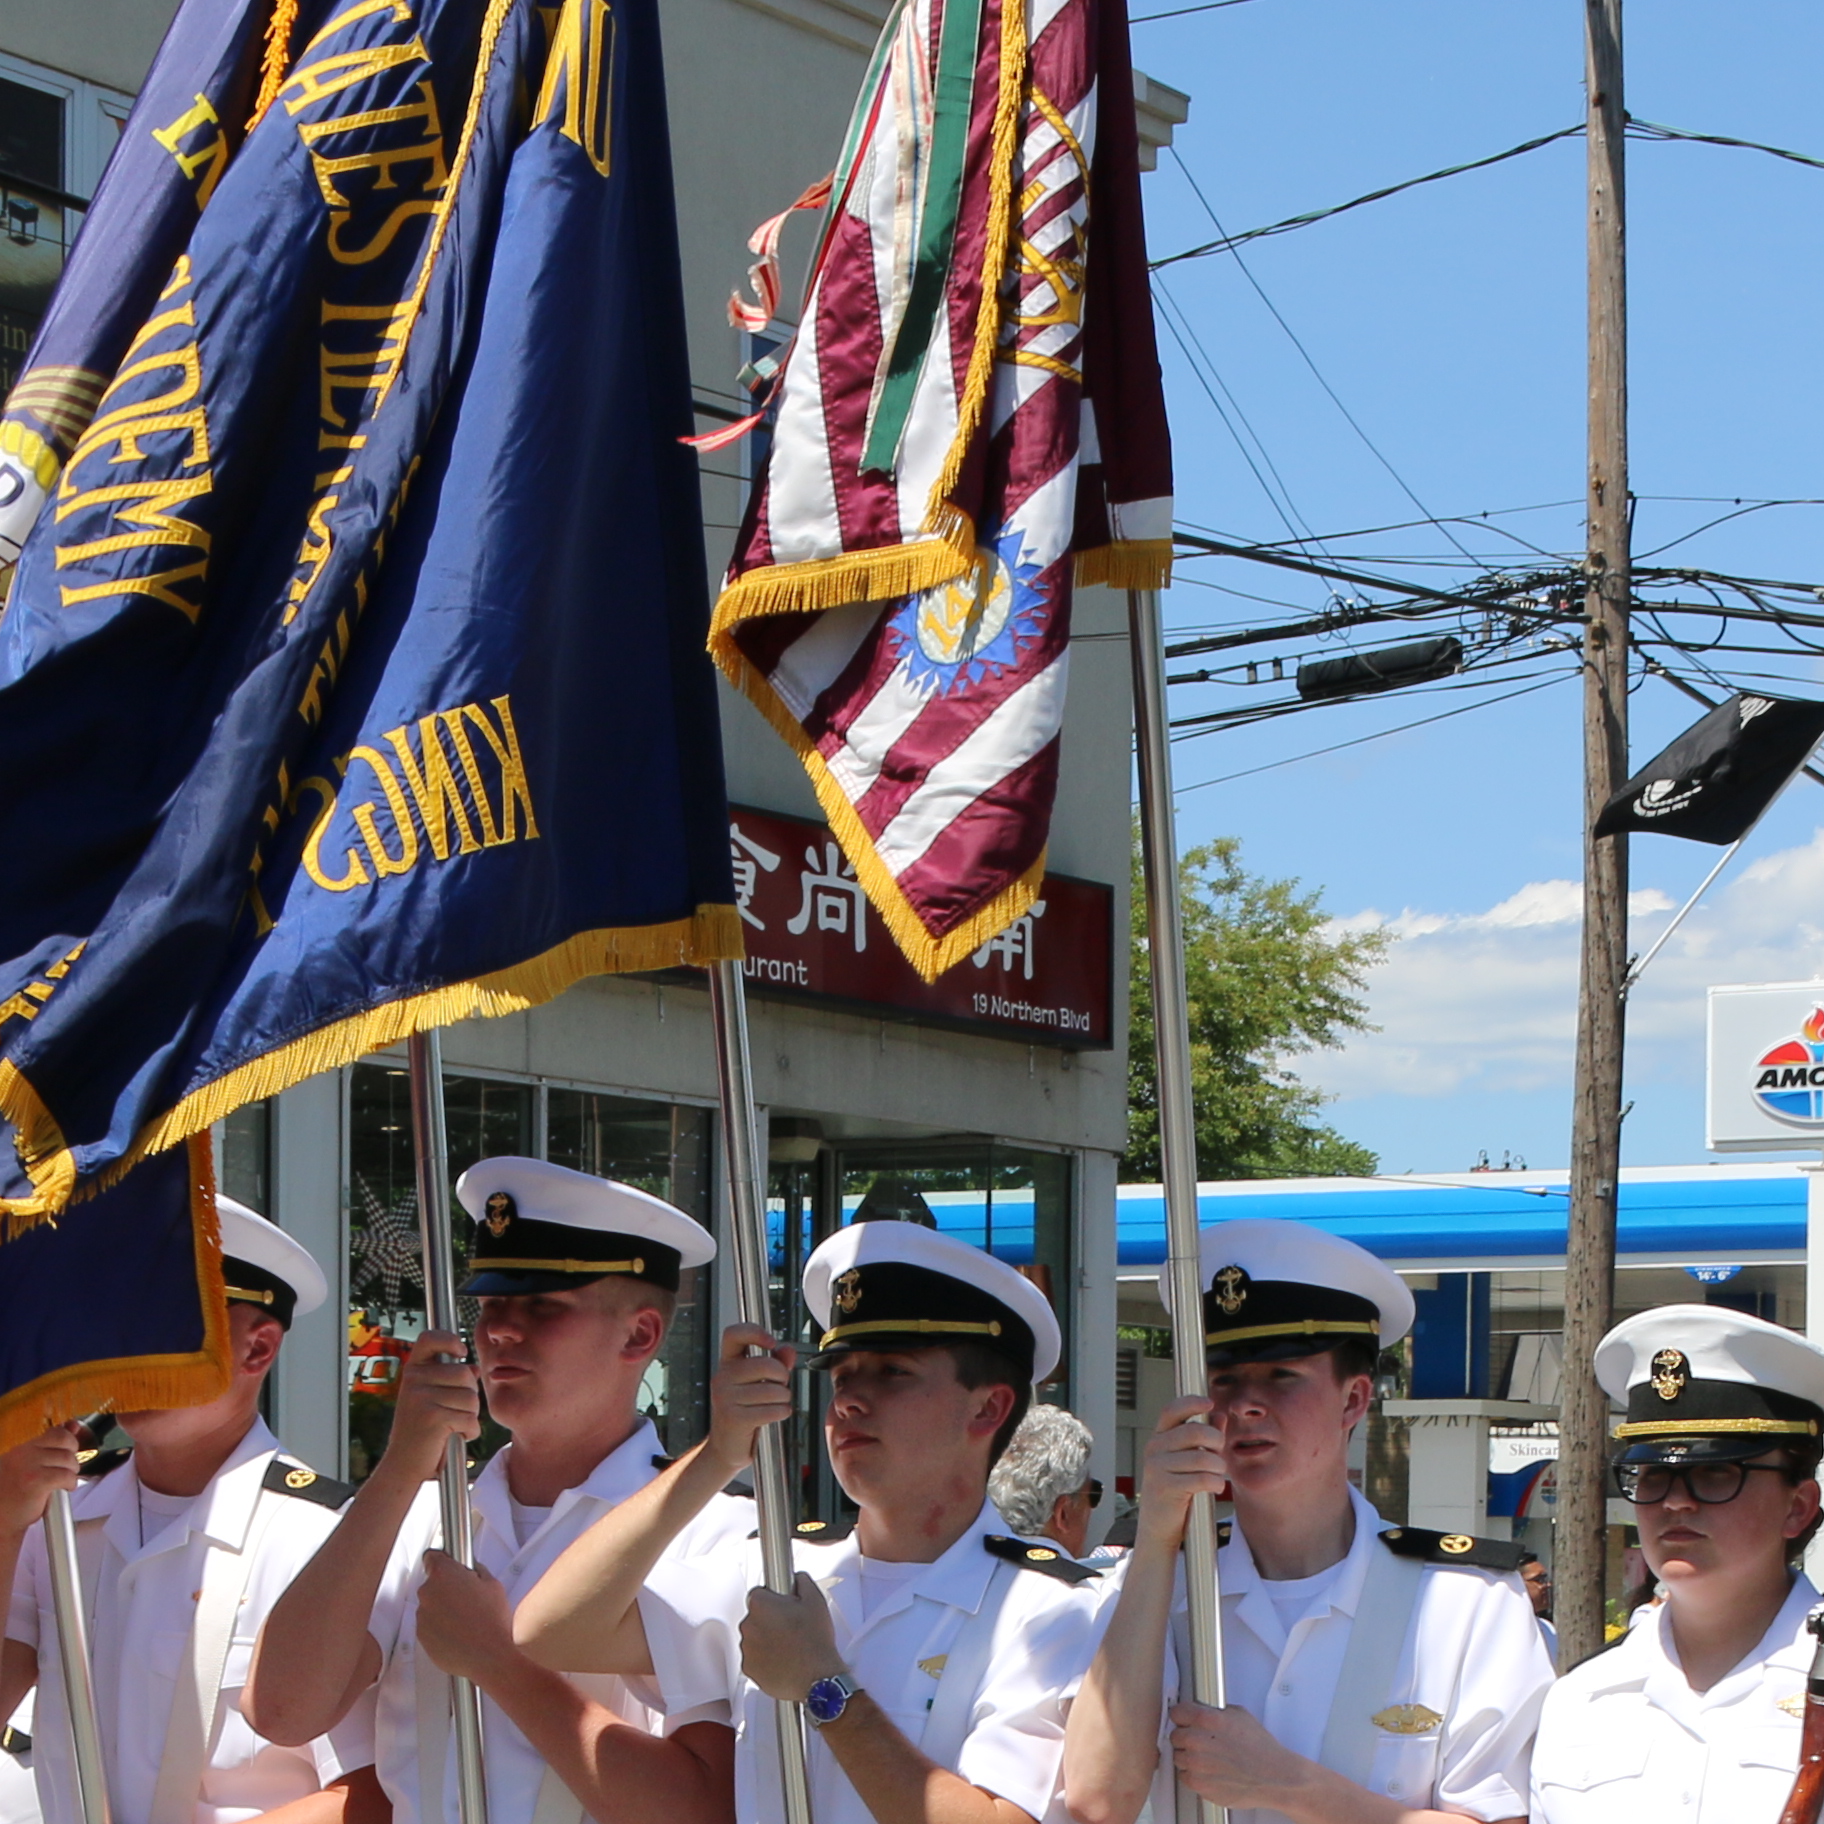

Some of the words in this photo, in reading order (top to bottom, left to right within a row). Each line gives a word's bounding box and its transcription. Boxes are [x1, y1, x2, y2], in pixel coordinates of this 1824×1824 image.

[973, 993, 988, 1013] 19
[991, 995, 1057, 1027] Northern
[1060, 1006, 1090, 1032] Blvd
[1509, 1443, 1558, 1456] Skincar
